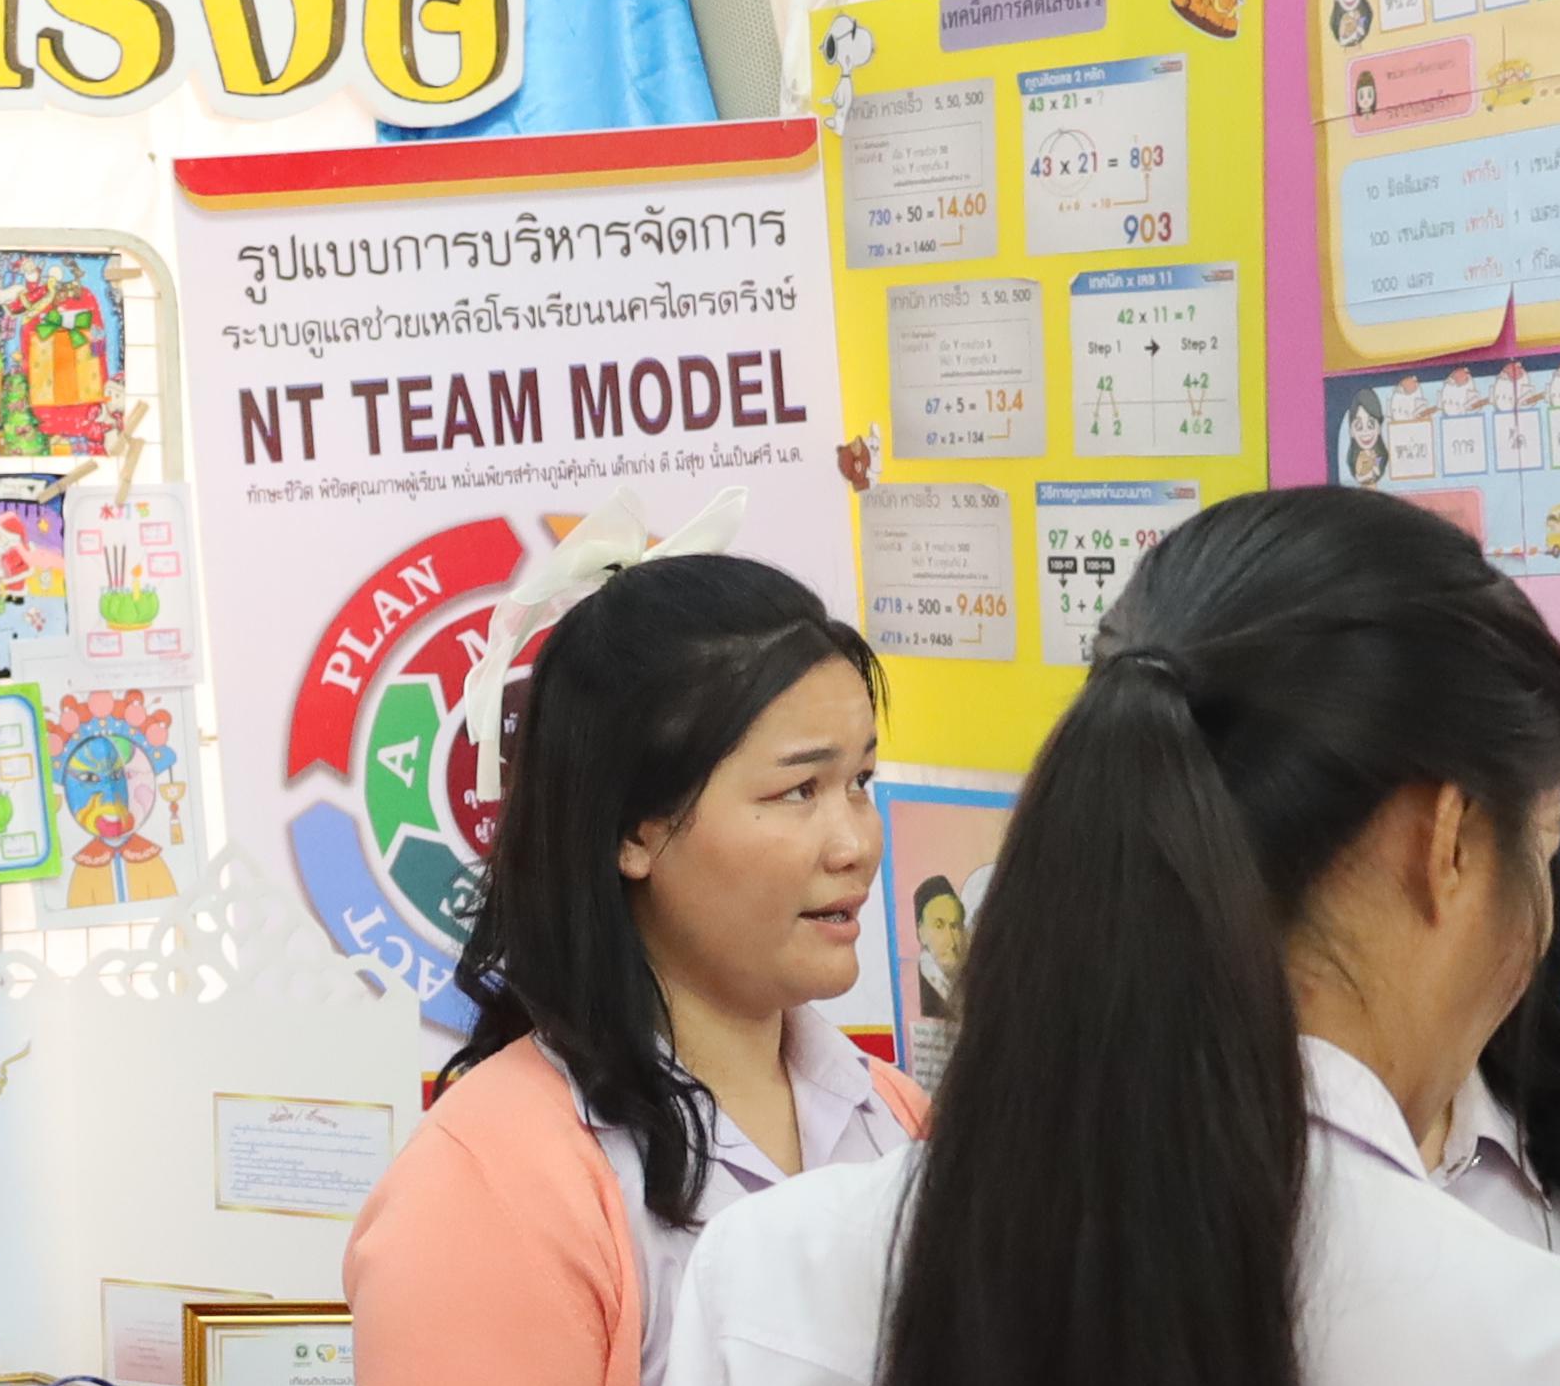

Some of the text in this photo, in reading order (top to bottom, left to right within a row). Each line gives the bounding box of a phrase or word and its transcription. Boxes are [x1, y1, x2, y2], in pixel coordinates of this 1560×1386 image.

[965, 91, 984, 107] 500
[1028, 96, 1045, 113] 43
[1062, 92, 1078, 109] 21
[1030, 144, 1164, 178] 43 21 803
[1366, 185, 1379, 200] 10
[868, 192, 987, 227] 730 50 14.60
[1123, 211, 1172, 245] 903
[867, 243, 885, 258] 730
[913, 240, 936, 254] 1460
[1369, 230, 1390, 248] 100
[237, 205, 788, 305] รูปแบบการบริหารจัดการ
[1370, 275, 1399, 294] 1000
[1012, 288, 1031, 303] 500
[221, 275, 799, 360] ระบบดูแลช่วยเหลือโรงเรียนนครไตรตรึงษ์
[1117, 304, 1196, 325] 42 11 ?
[1087, 340, 1112, 358] Step
[1181, 336, 1218, 354] Step 2
[1096, 375, 1114, 392] 42
[1183, 372, 1210, 390] 4+2
[237, 382, 325, 465] NT
[350, 367, 540, 456] TEAM
[569, 348, 808, 440] MODEL
[924, 388, 1025, 415] 67 5 13.4
[926, 429, 985, 446] 67 2 134
[1090, 419, 1122, 436] 4 2
[1451, 437, 1475, 455] การ
[246, 479, 314, 506] ทักษะชีวิต
[659, 455, 671, 475] ดี
[675, 452, 706, 479] มีสุข
[981, 493, 1000, 509] 500
[1048, 529, 1114, 550] 97 96
[873, 593, 1008, 617] 4718 500 9.436
[1060, 593, 1104, 613] 3 4
[319, 554, 443, 695] PLAN
[880, 631, 903, 645] 4718
[930, 633, 953, 647] 9436
[376, 734, 420, 788] A
[342, 905, 454, 1003] ACT
